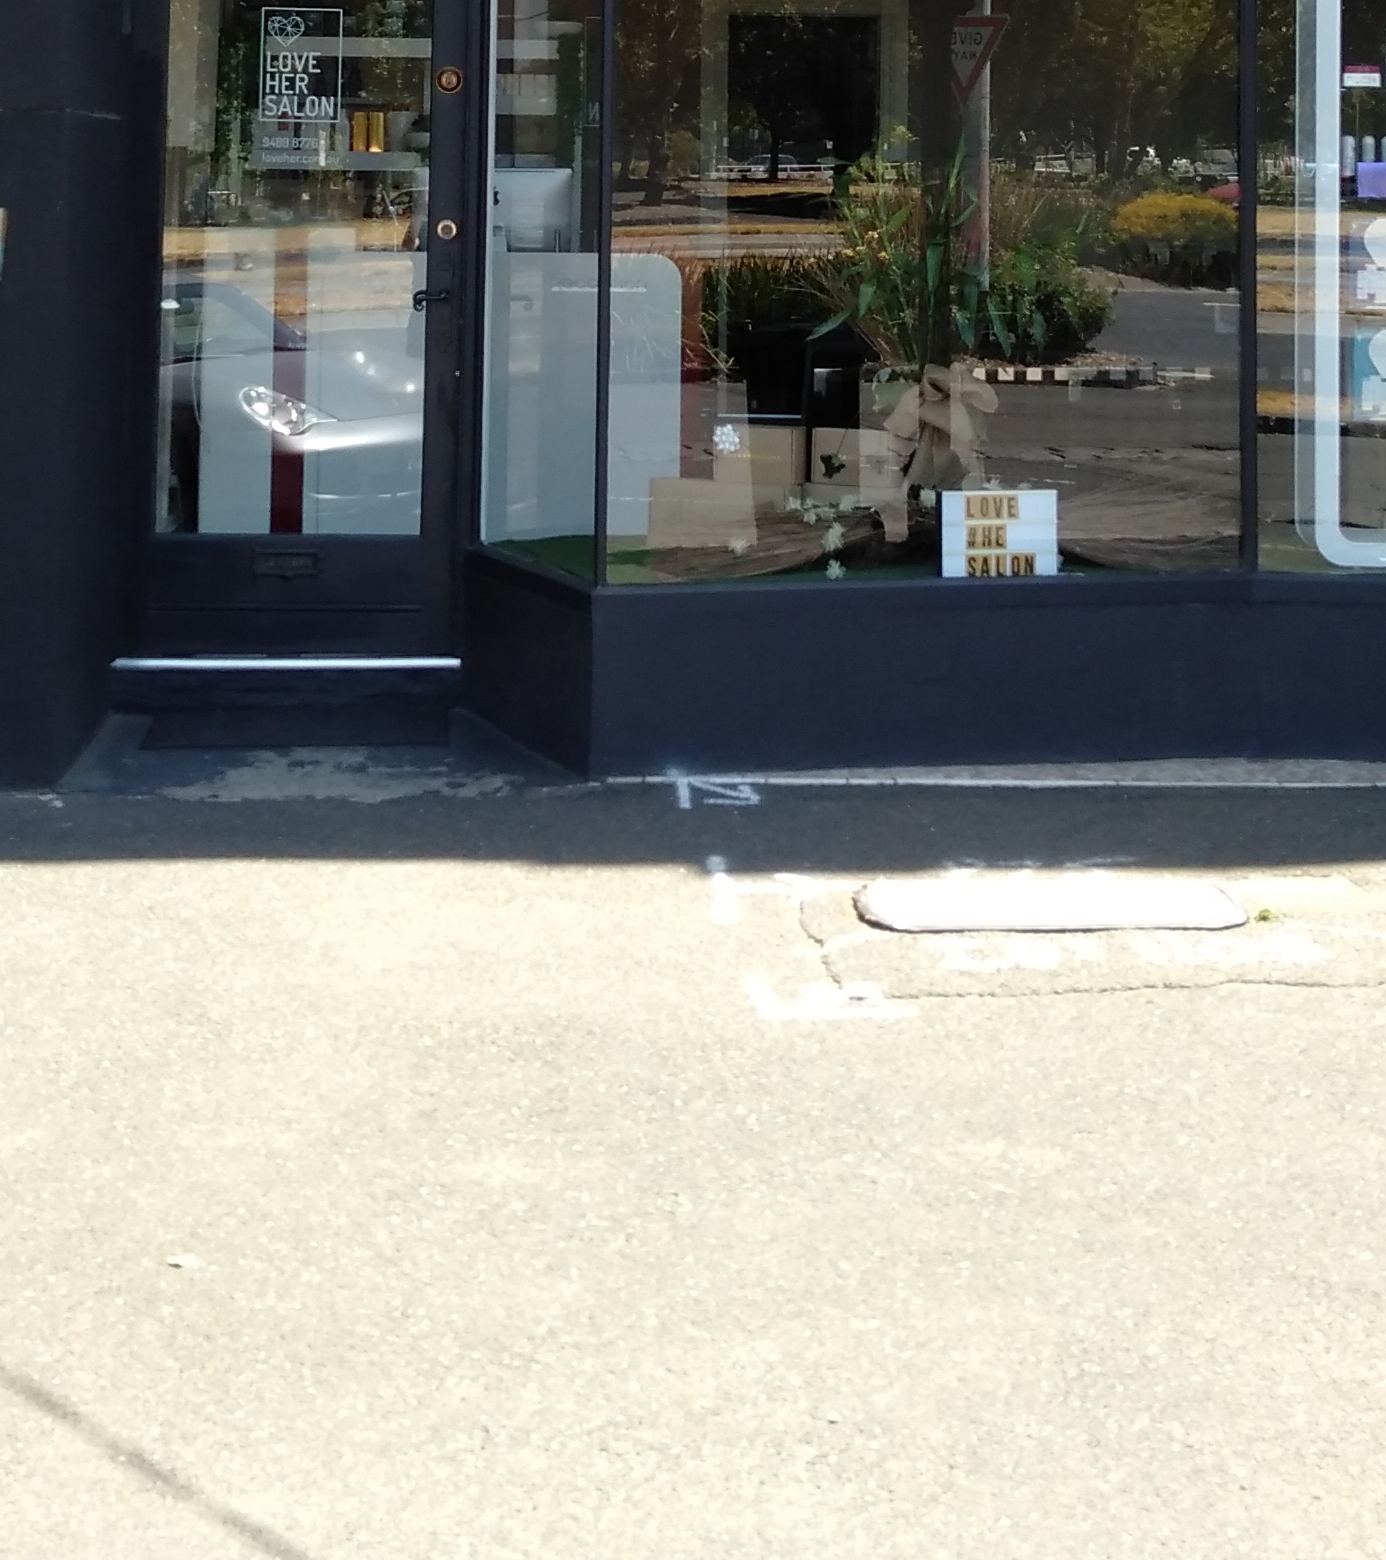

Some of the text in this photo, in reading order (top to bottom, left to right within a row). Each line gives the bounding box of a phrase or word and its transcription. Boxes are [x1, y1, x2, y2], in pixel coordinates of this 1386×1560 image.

[265, 51, 322, 73] LOVE
[265, 73, 309, 94] HER
[264, 95, 335, 117] SALON
[262, 137, 318, 148] 9489 8776
[966, 496, 1018, 518] LOVE
[967, 555, 1035, 577] SALON
